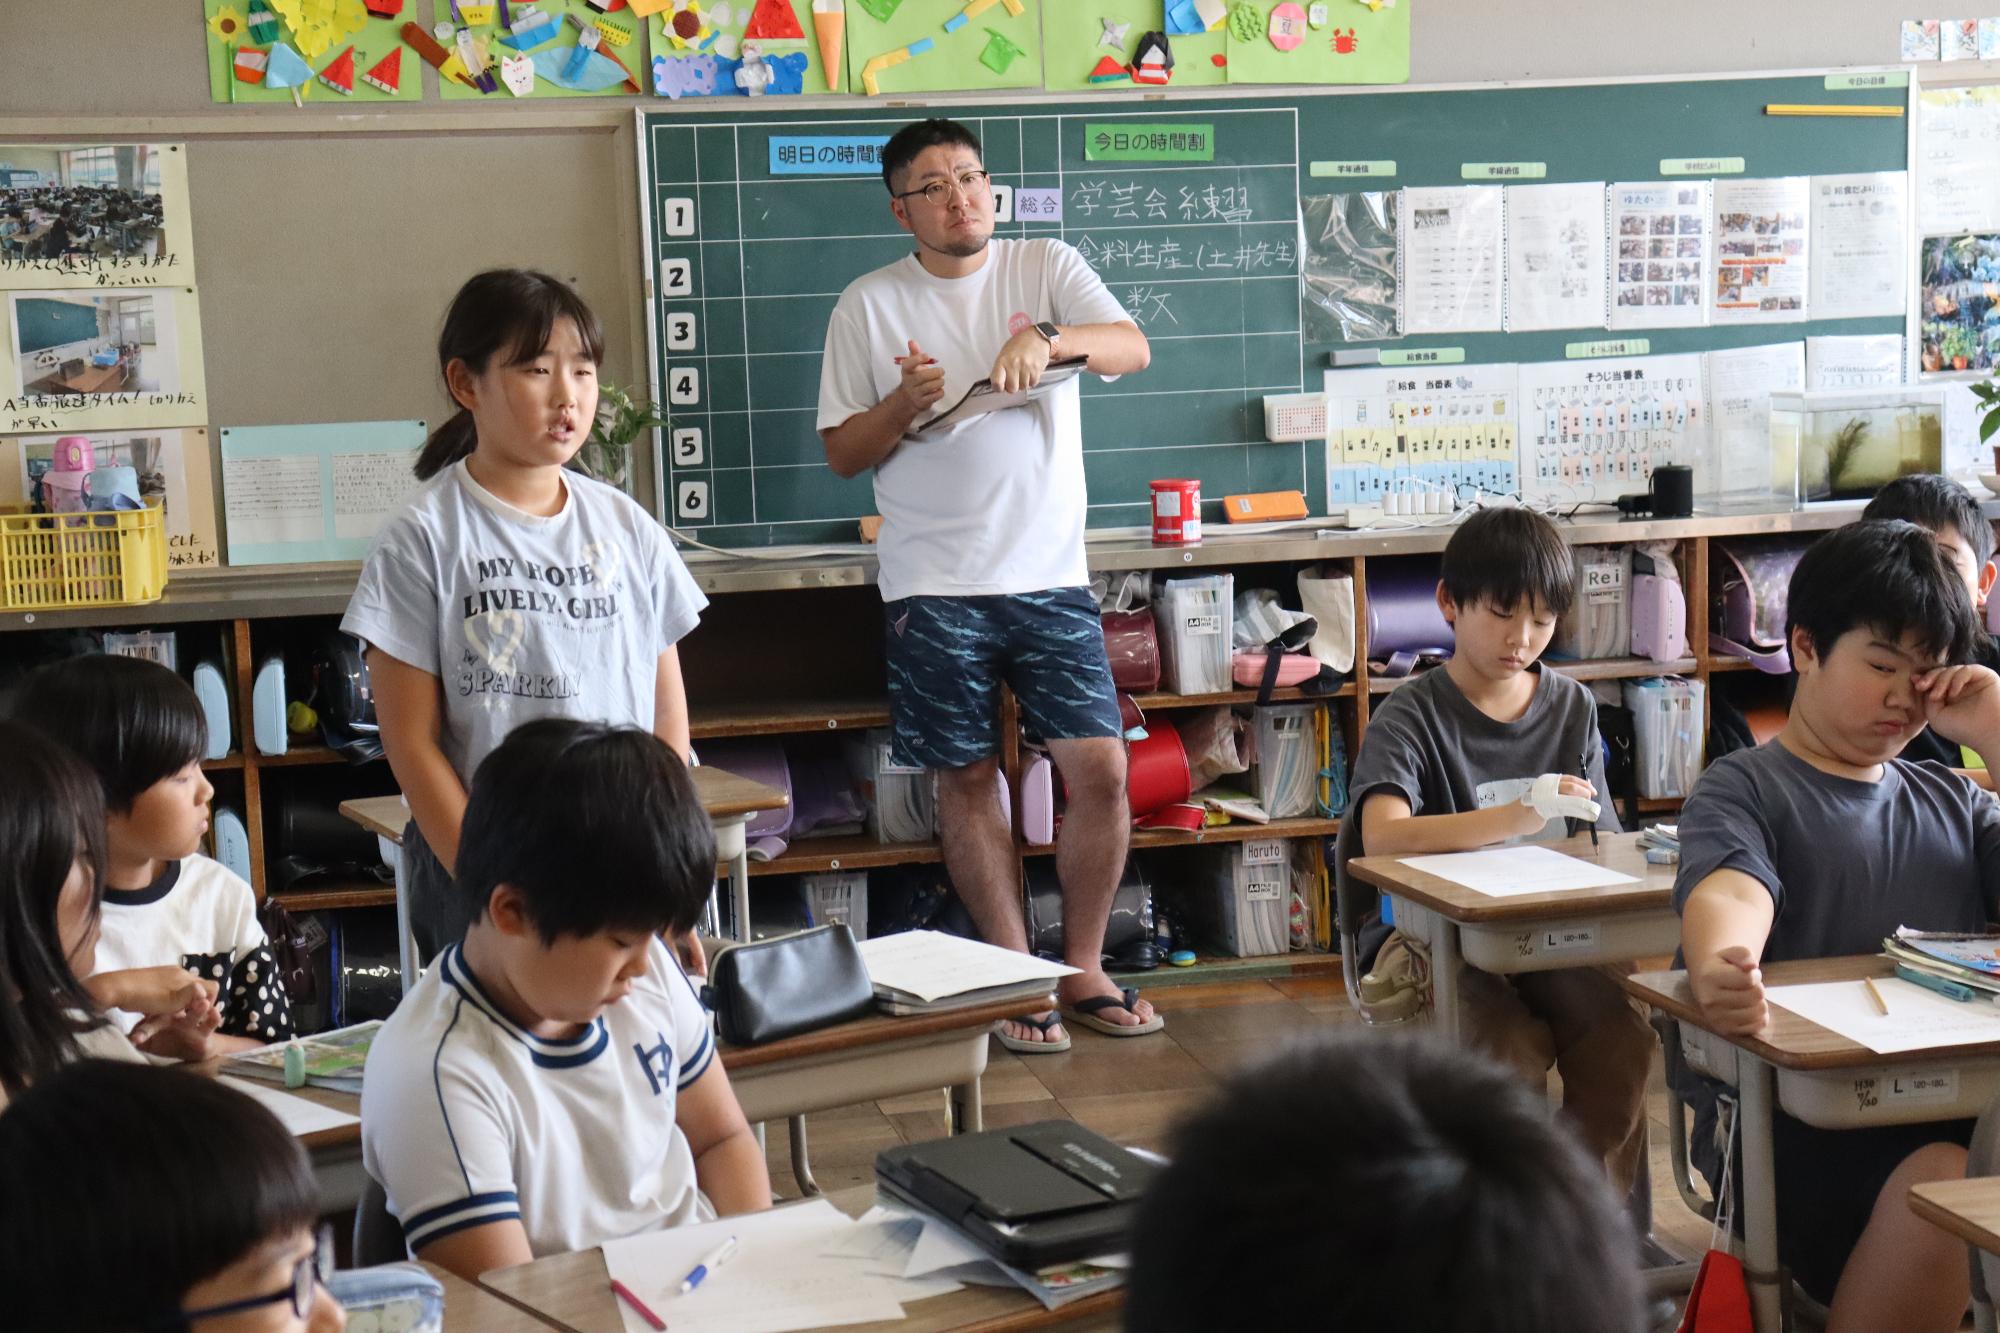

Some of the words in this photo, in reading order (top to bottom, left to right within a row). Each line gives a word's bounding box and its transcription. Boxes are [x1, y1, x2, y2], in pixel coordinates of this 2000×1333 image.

[1095, 132, 1205, 151] 今日の時間割
[995, 193, 1003, 213] 1
[1020, 195, 1058, 214] 総合
[675, 206, 684, 227] 1
[96, 273, 157, 286] かっこいい
[669, 267, 684, 287] 2
[674, 321, 689, 341] 3
[1586, 369, 1644, 382] そうじ当番表
[676, 376, 692, 396] 4
[1398, 381, 1416, 390] 給食
[681, 436, 696, 457] 5
[685, 490, 701, 510] 6
[478, 557, 515, 583] MY
[526, 560, 595, 587] HOPE
[1589, 568, 1620, 585] Rei
[567, 594, 619, 620] GIRL
[457, 668, 582, 700] SPARKLY
[1248, 843, 1280, 858] Haruto
[1248, 884, 1260, 892] A4
[1548, 934, 1557, 946] L
[1894, 1078, 1904, 1094] L
